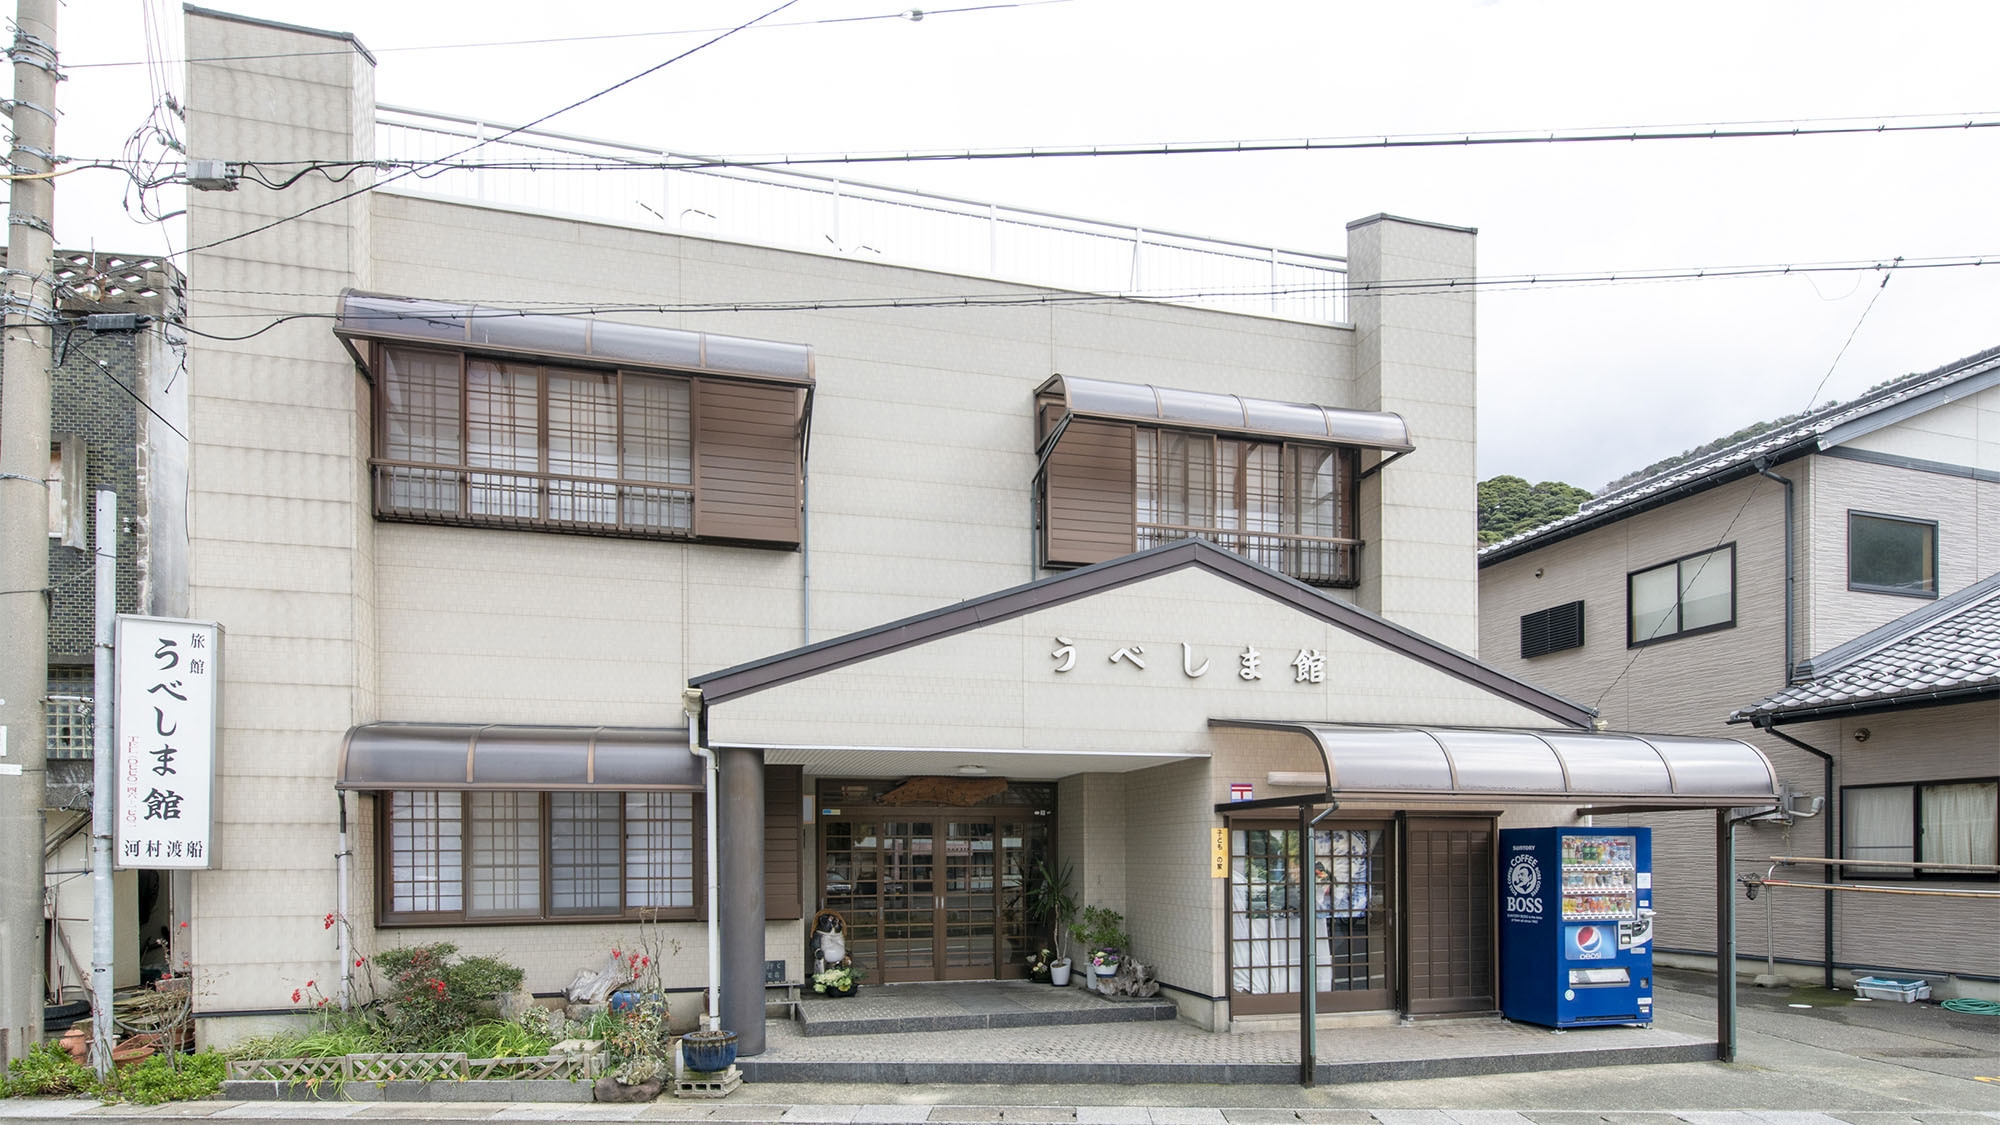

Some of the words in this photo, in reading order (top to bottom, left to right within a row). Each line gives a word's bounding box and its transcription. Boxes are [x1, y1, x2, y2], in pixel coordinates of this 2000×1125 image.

[189, 632, 206, 675] 旅館
[1050, 636, 1328, 684] うべしま館
[143, 638, 187, 821] うべしま館
[124, 839, 204, 859] 河村渡船
[1510, 854, 1538, 867] COFFEE
[1507, 897, 1543, 913] BOSS
